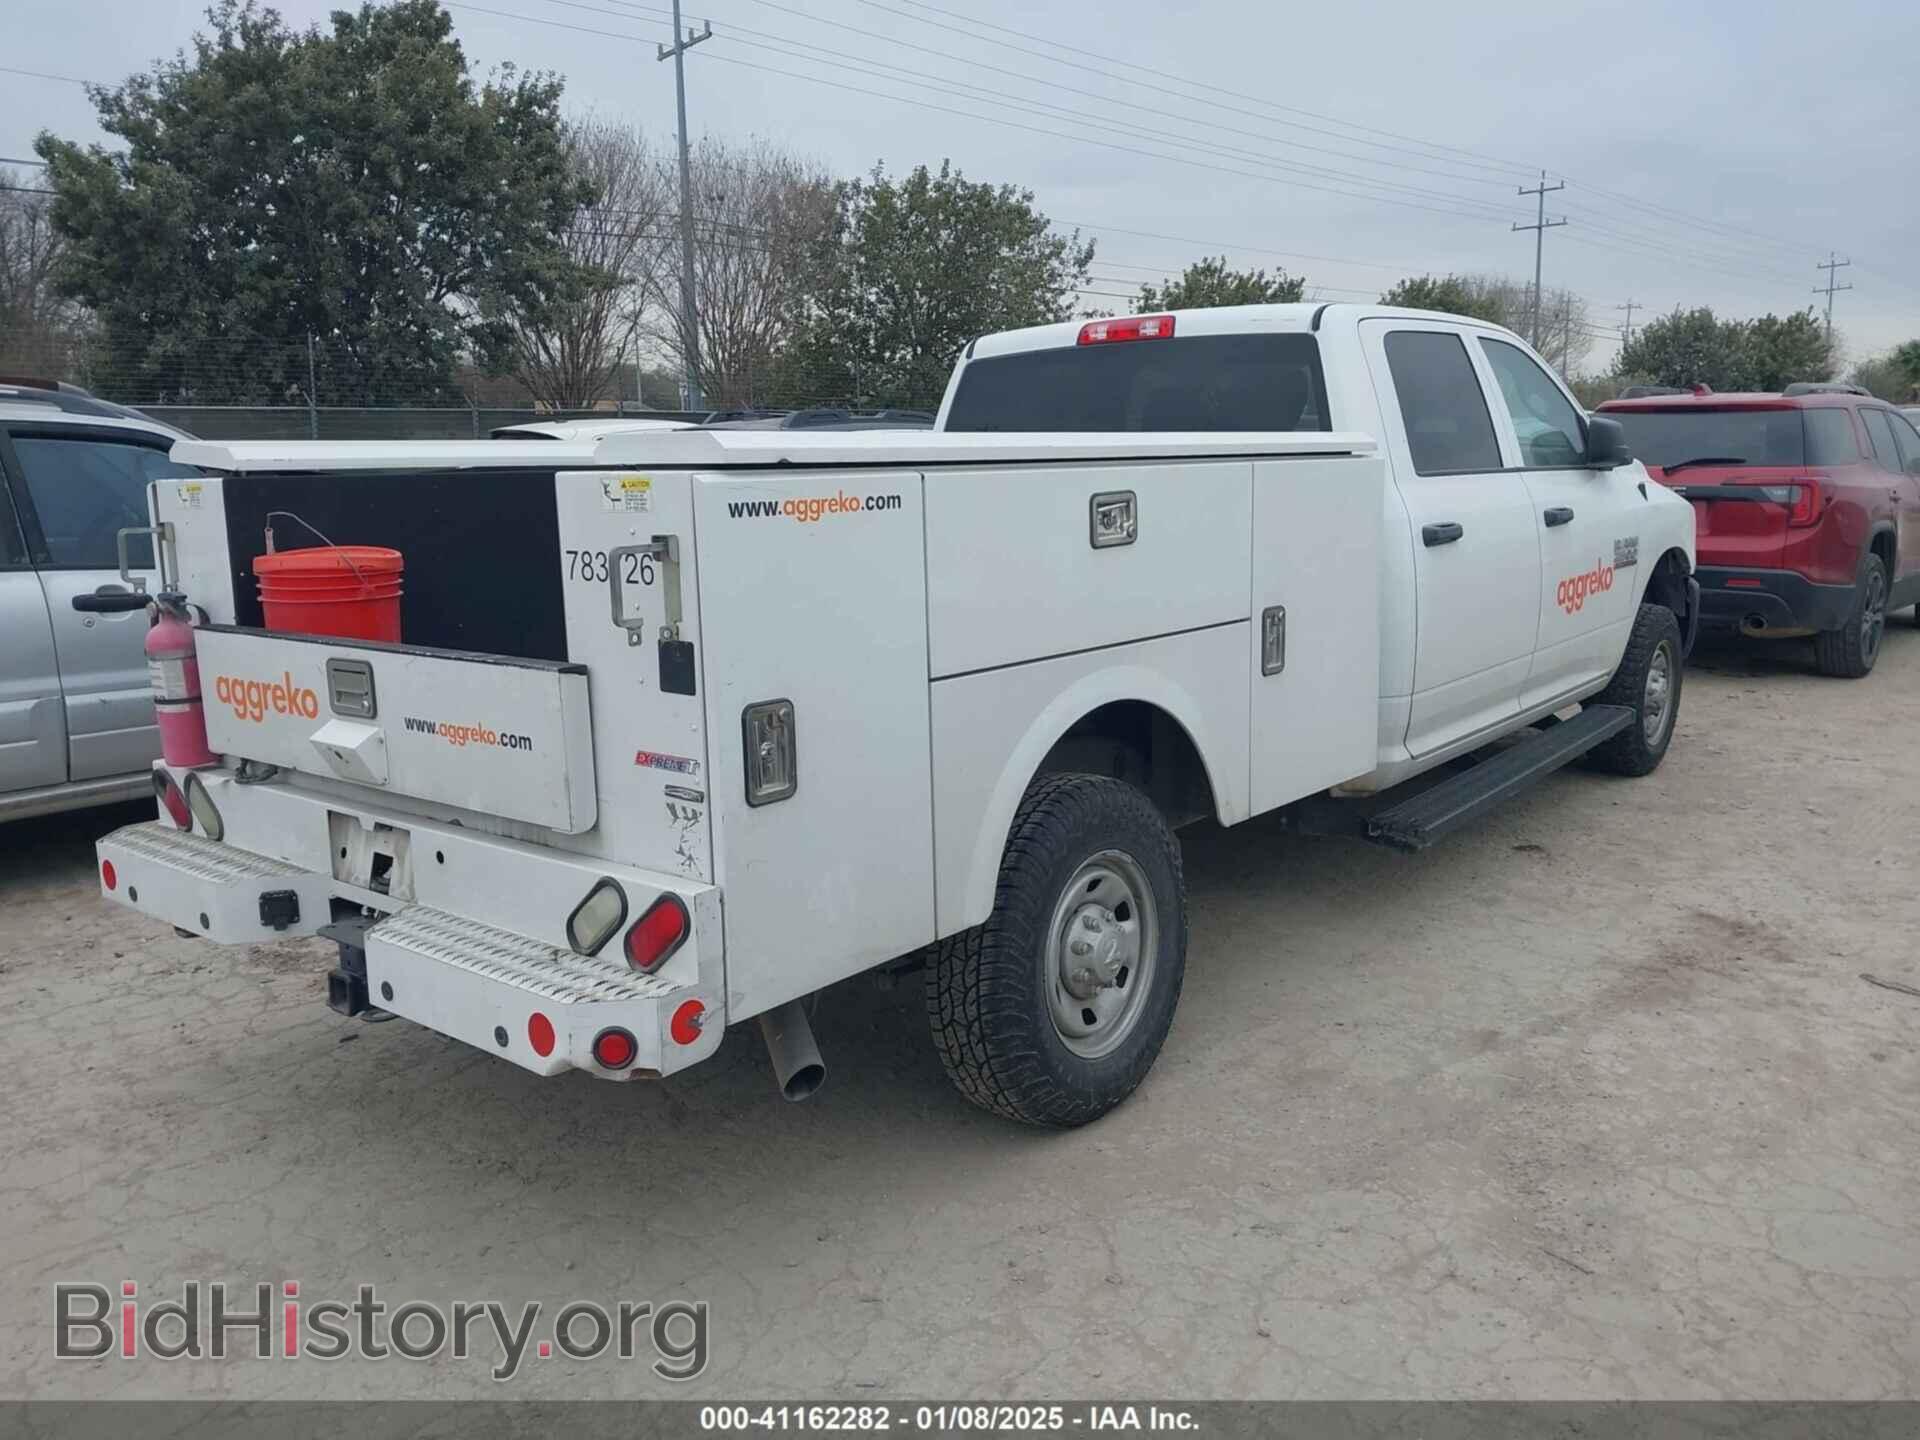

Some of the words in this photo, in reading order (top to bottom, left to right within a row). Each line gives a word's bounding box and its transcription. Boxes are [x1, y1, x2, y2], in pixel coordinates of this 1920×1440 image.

[728, 490, 902, 522] www.aggreko.com
[1557, 557, 1613, 614] aggreko
[216, 671, 318, 723] aggreko
[403, 717, 533, 751] www.aggreko.com
